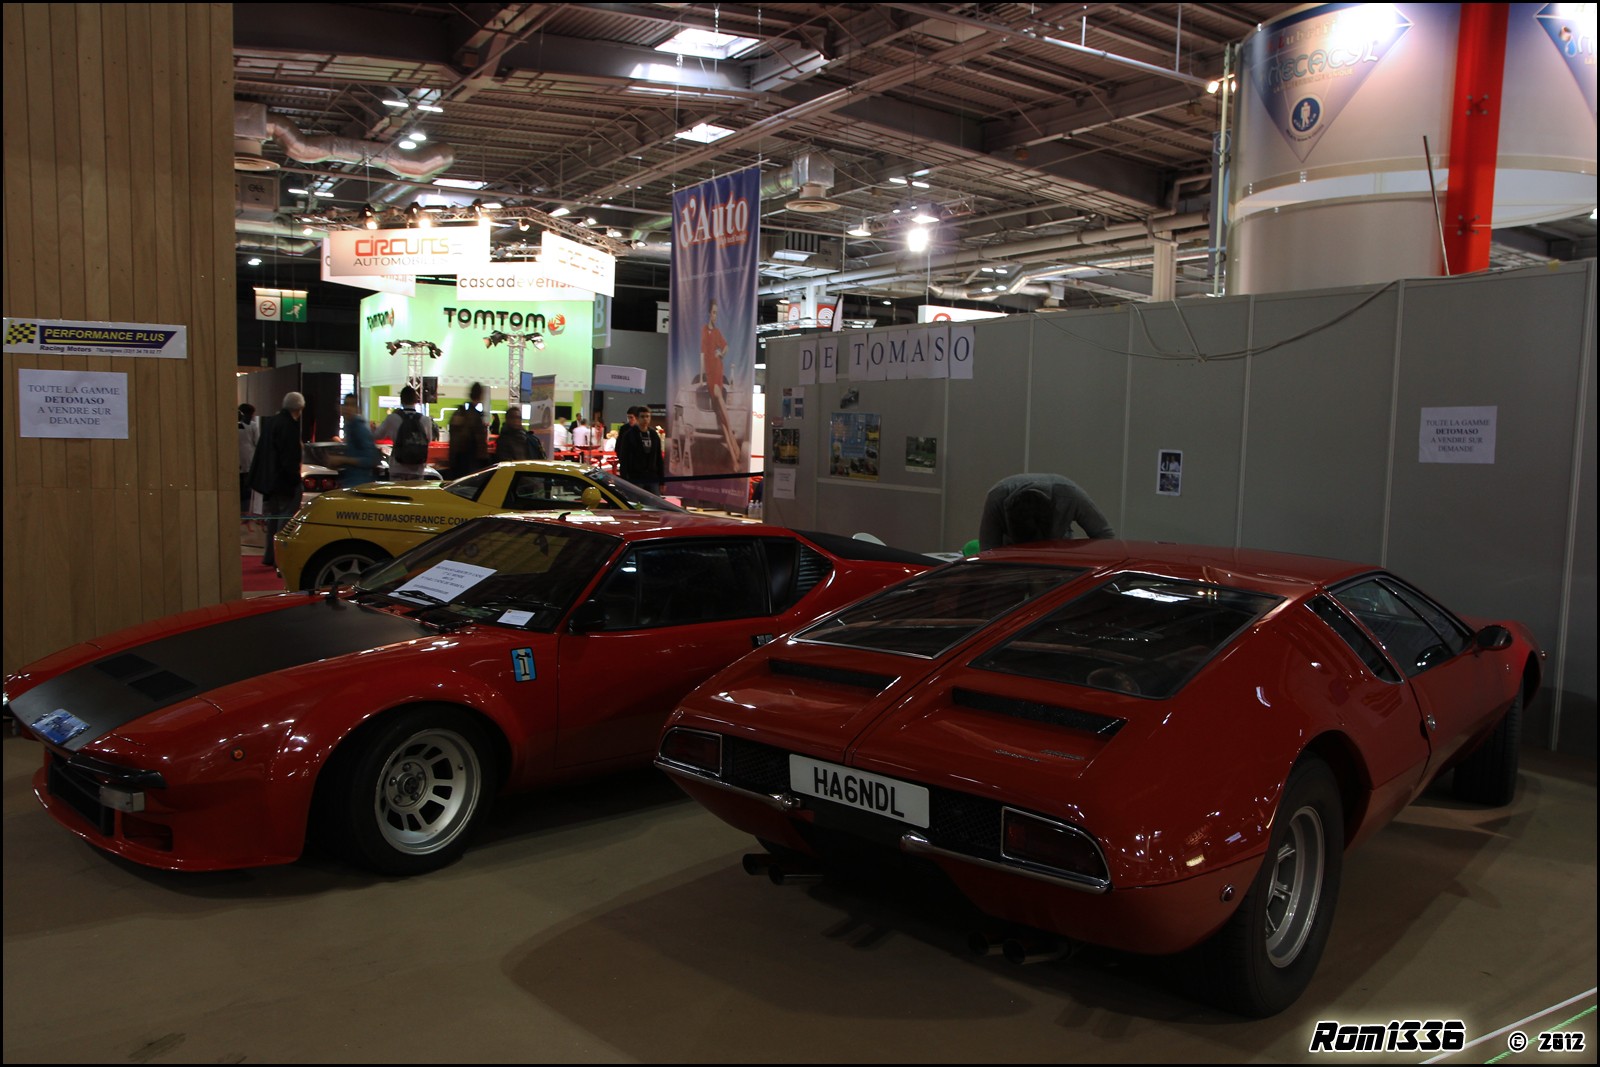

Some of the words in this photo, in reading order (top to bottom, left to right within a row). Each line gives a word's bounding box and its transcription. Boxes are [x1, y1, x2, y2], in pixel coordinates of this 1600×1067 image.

[44, 328, 133, 341] PERFORMANCE
[135, 333, 165, 342] PLUS
[40, 345, 65, 353] Racing
[802, 346, 833, 370] DE
[854, 336, 969, 366] TOMASO
[28, 384, 62, 393] TOUTE
[65, 386, 78, 394] LA
[81, 387, 120, 395] GAMME
[44, 396, 104, 405] DETOMASO
[49, 417, 100, 425] DEMANDE
[813, 767, 905, 818] HA6NDL
